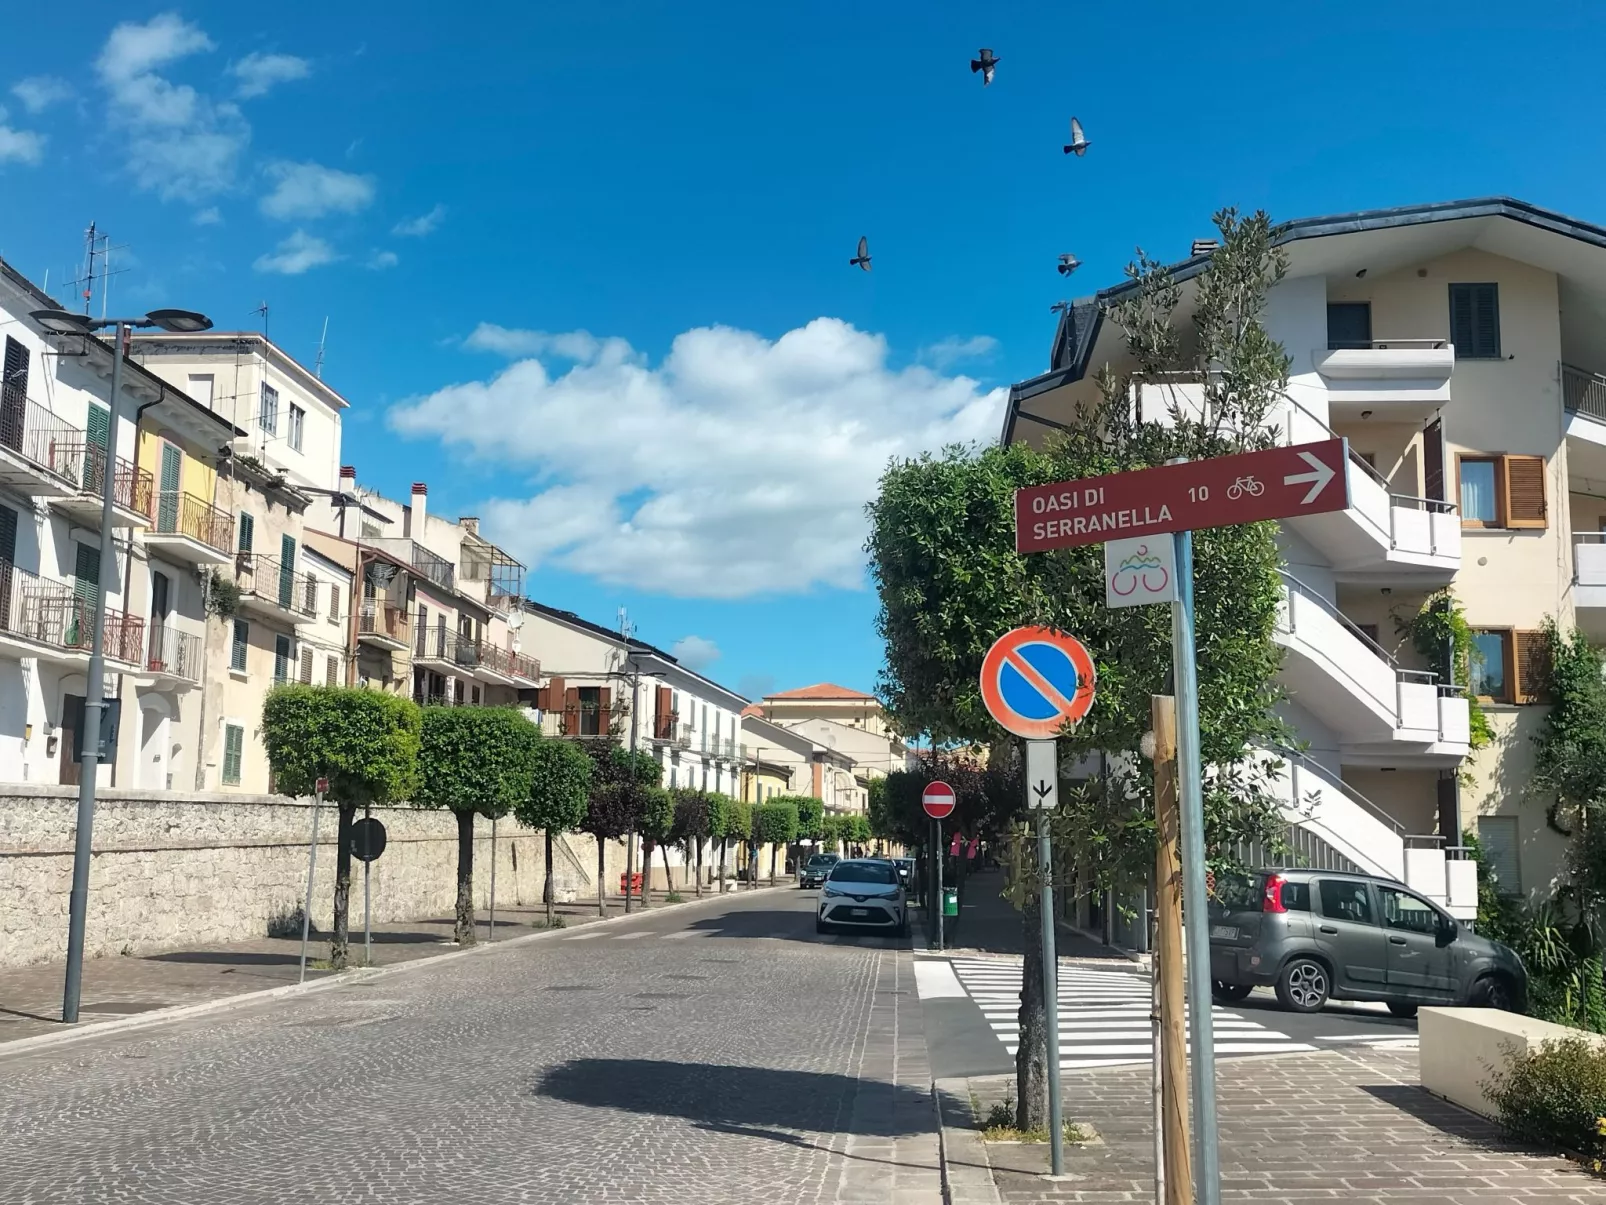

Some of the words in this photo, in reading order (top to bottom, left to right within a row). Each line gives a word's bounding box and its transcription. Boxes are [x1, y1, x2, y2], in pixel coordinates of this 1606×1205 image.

[1032, 491, 1078, 514] OASI
[1084, 487, 1105, 507] DI
[1188, 486, 1209, 503] 10
[1033, 504, 1173, 540] SERRANELLA
